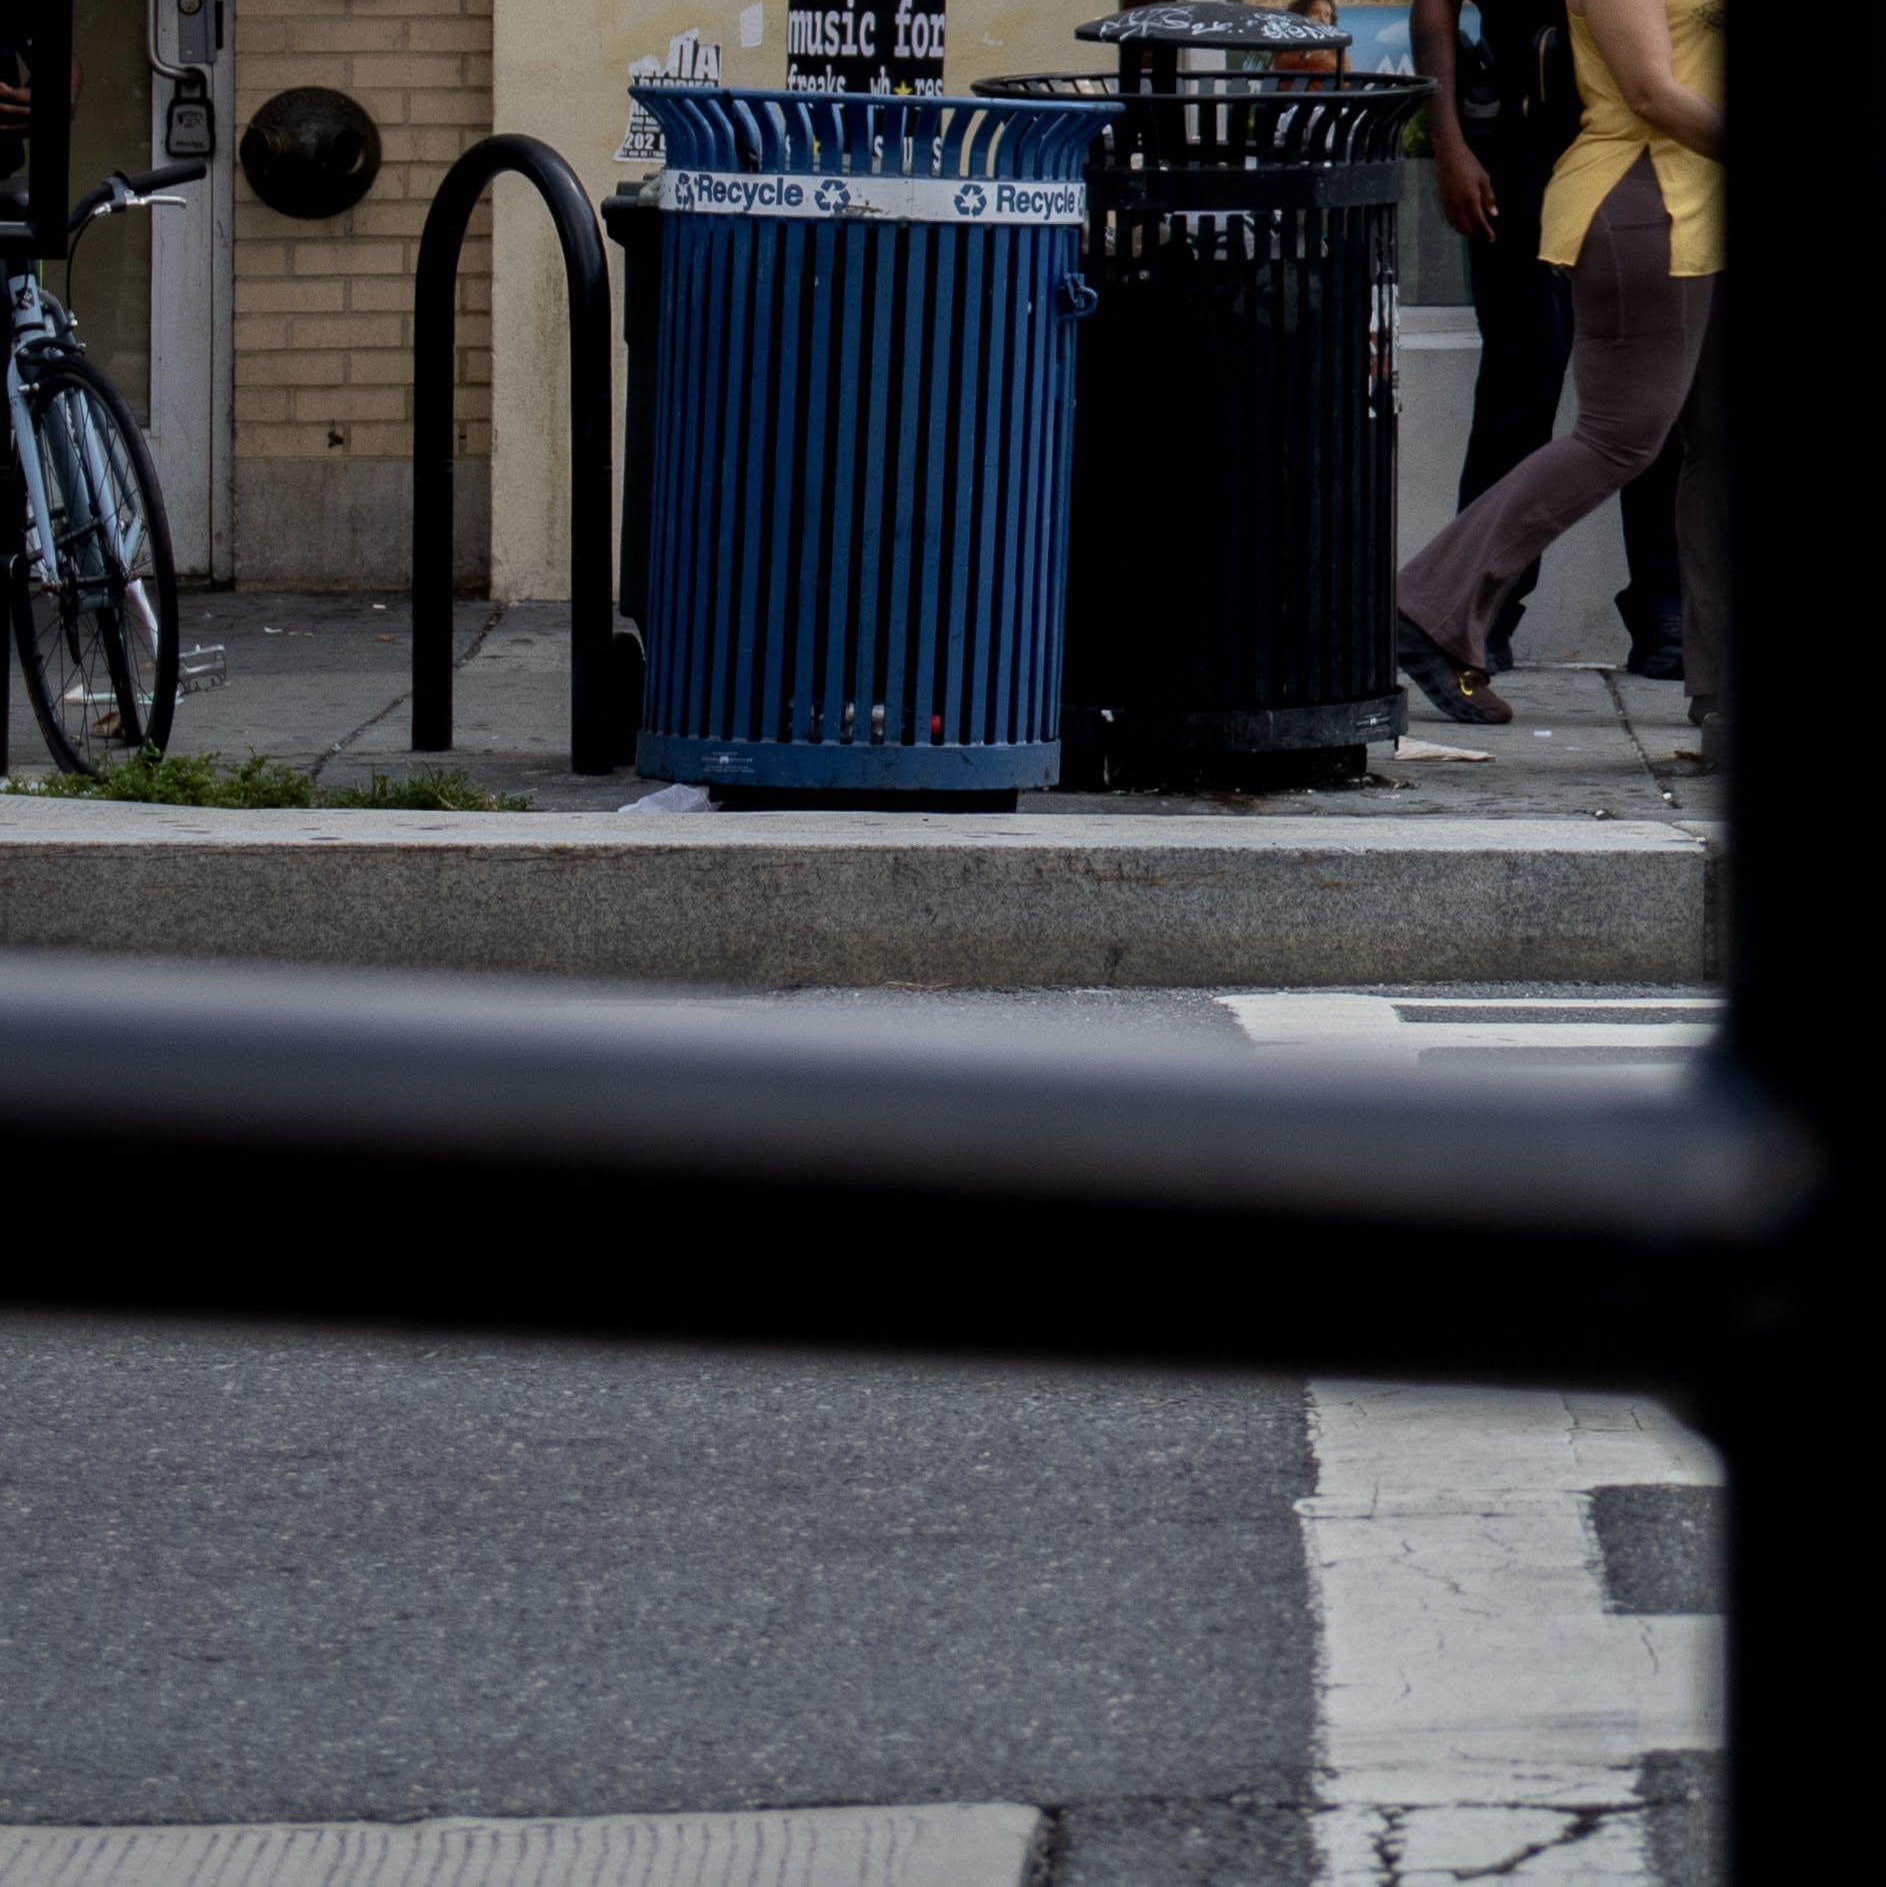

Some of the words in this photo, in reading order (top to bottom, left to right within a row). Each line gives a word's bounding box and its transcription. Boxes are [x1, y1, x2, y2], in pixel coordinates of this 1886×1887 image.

[788, 64, 847, 93] freaks
[624, 132, 655, 150] 202
[698, 177, 803, 210] Recycle
[997, 185, 1075, 220] Recycle
